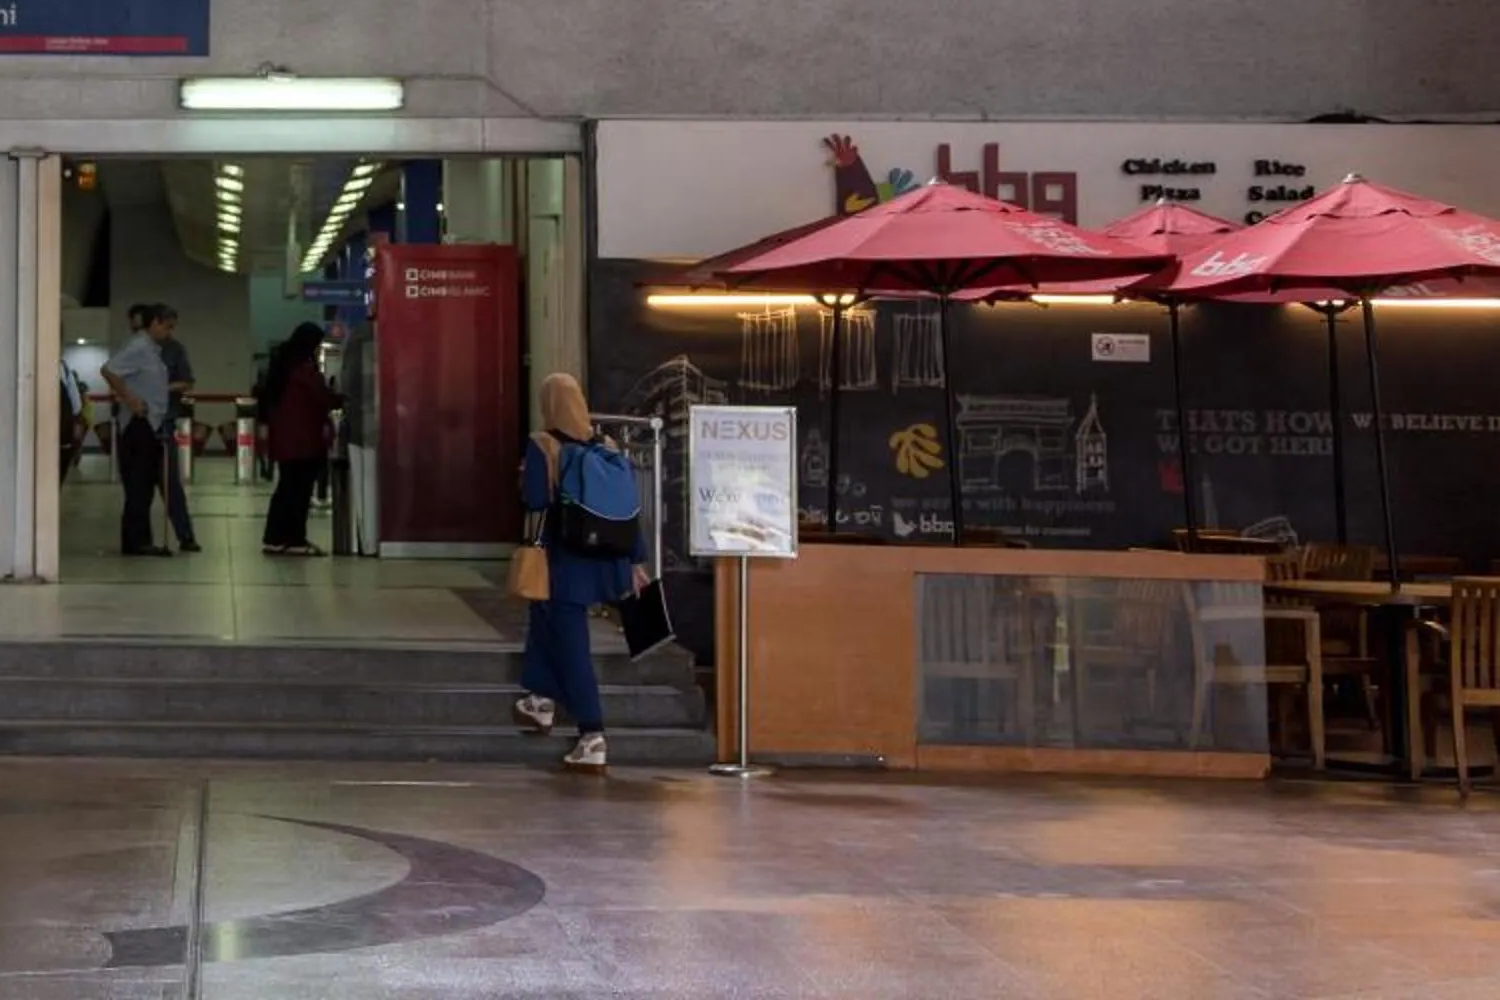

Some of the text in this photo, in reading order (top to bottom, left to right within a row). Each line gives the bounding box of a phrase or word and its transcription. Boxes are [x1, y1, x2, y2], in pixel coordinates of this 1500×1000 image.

[1122, 158, 1216, 174] Chicken
[1255, 159, 1306, 177] Rice
[1141, 185, 1201, 201] Pizza
[1248, 185, 1315, 201] Salad
[701, 419, 788, 441] NEXUS
[1265, 410, 1334, 434] HOW
[1391, 413, 1483, 431] BELIEVE
[1205, 435, 1262, 455] GOT
